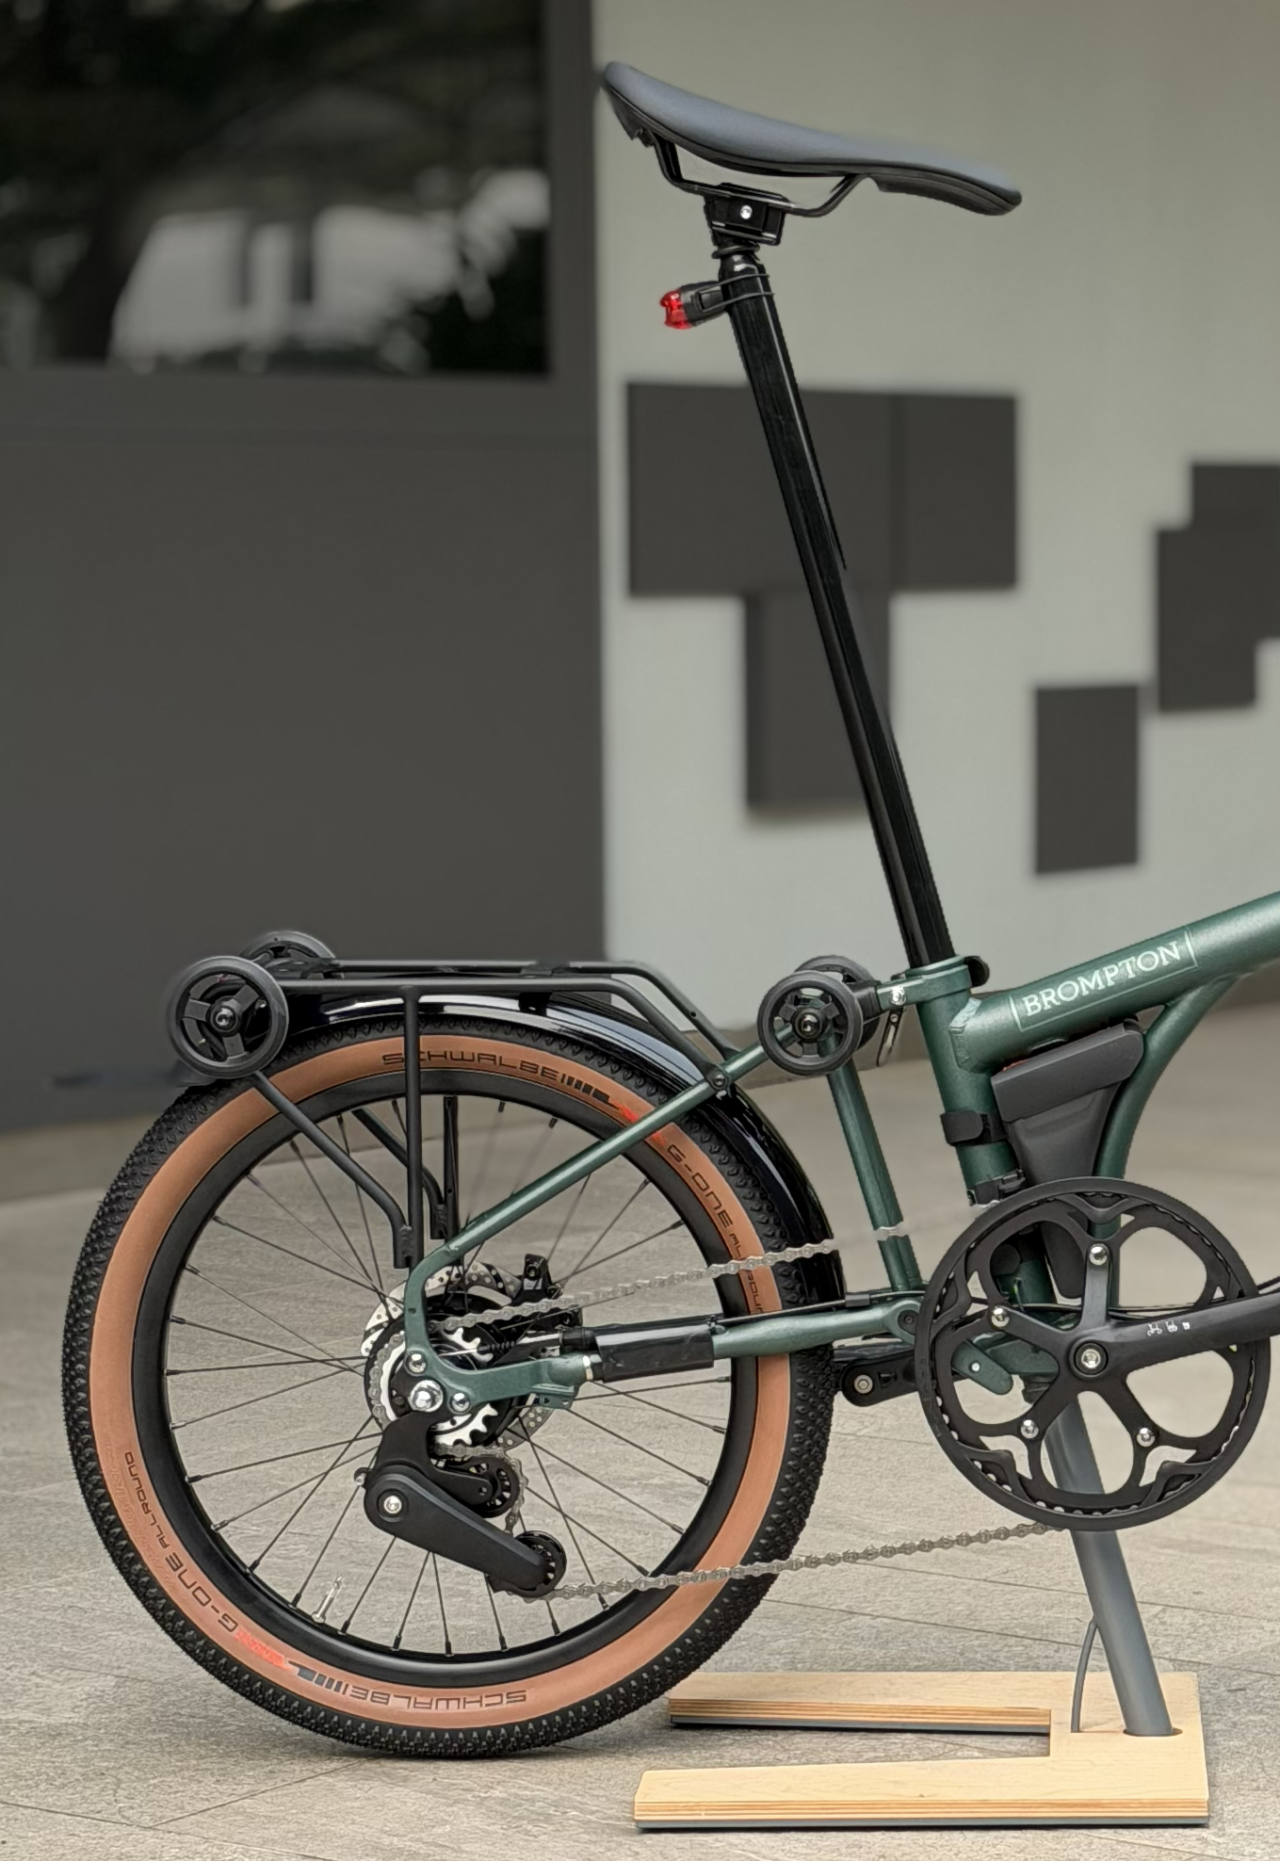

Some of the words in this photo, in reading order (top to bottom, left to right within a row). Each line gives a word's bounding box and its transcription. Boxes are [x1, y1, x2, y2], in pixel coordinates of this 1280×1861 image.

[1022, 941, 1181, 1017] BROMPTON
[382, 1050, 558, 1081] SHWALBE
[667, 1144, 734, 1229] G-ONE
[125, 1451, 170, 1549] ALLROUND
[165, 1552, 239, 1633] G-ONE
[350, 1685, 527, 1711] SCHWALBE
